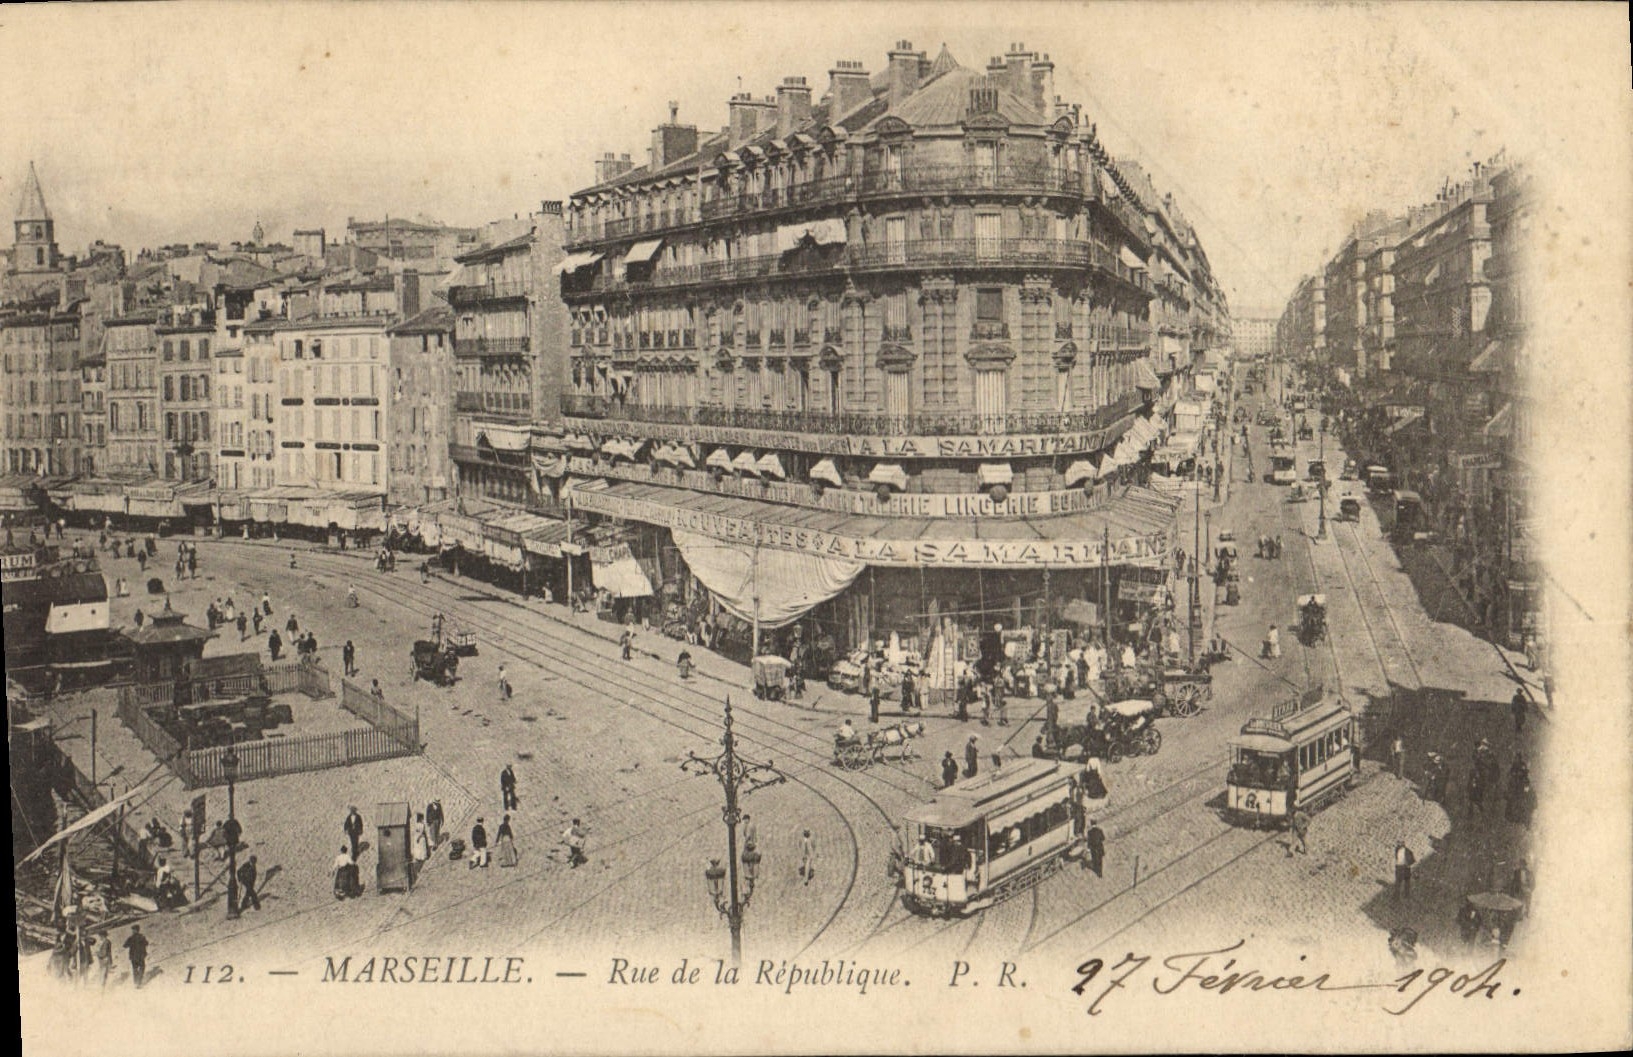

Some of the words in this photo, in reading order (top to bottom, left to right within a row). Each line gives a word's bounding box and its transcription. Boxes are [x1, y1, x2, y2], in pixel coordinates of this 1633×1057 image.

[859, 437, 880, 456] A
[883, 438, 926, 457] LA
[944, 493, 1039, 517] LINGERIE
[823, 539, 851, 557] A
[855, 541, 907, 562] LA
[915, 536, 1167, 565] SAMARITAINE
[1070, 951, 1153, 1017] 27
